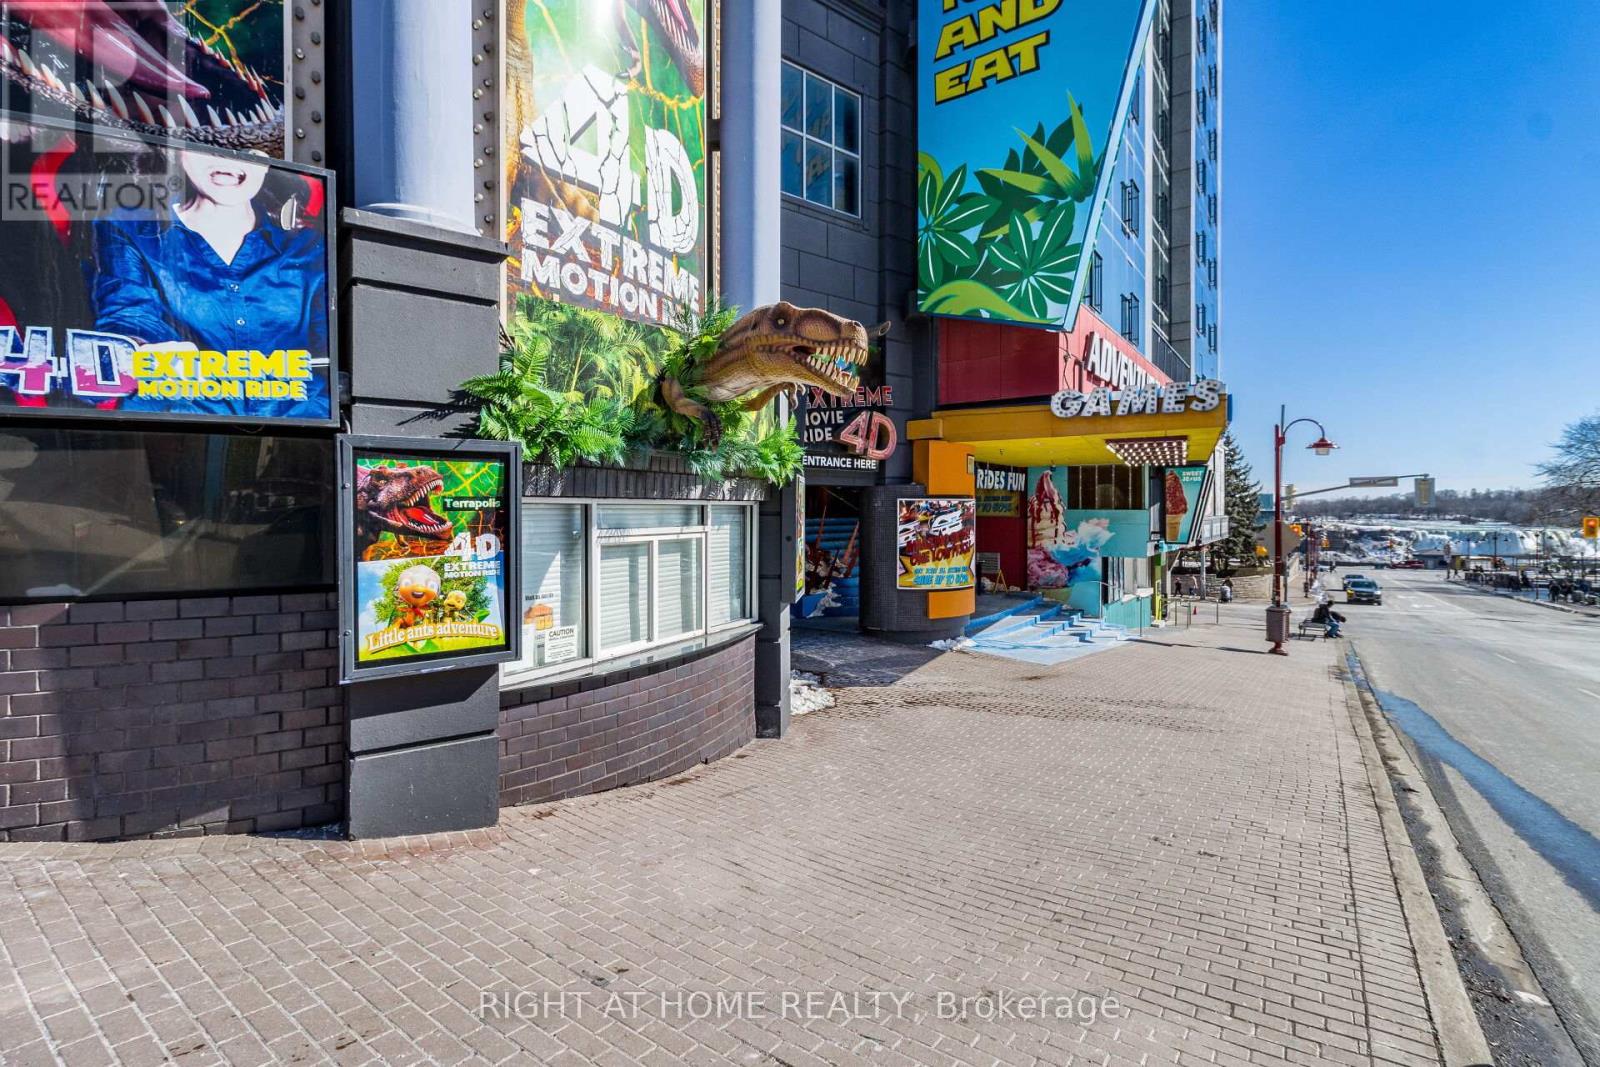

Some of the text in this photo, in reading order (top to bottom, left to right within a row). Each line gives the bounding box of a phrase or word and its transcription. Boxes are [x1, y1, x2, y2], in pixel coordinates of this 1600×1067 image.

[934, 0, 1063, 62] AND
[935, 30, 1050, 105] EAT
[519, 62, 699, 255] 4D
[520, 196, 700, 316] EXTREME
[521, 247, 659, 323] MOTION
[132, 350, 311, 380] EXTREME
[138, 380, 308, 399] MOTION RIDE
[1051, 379, 1222, 418] GAMES
[840, 410, 897, 460] 4D
[802, 456, 877, 469] ENTRANCE HERE
[1007, 472, 1026, 491] FUN
[444, 498, 501, 510] Terrapolis
[444, 532, 501, 561] 4D
[444, 561, 501, 571] EXTREME
[444, 571, 482, 579] MOTION
[368, 619, 498, 650] Little ants adventure
[549, 628, 574, 638] CAUTION
